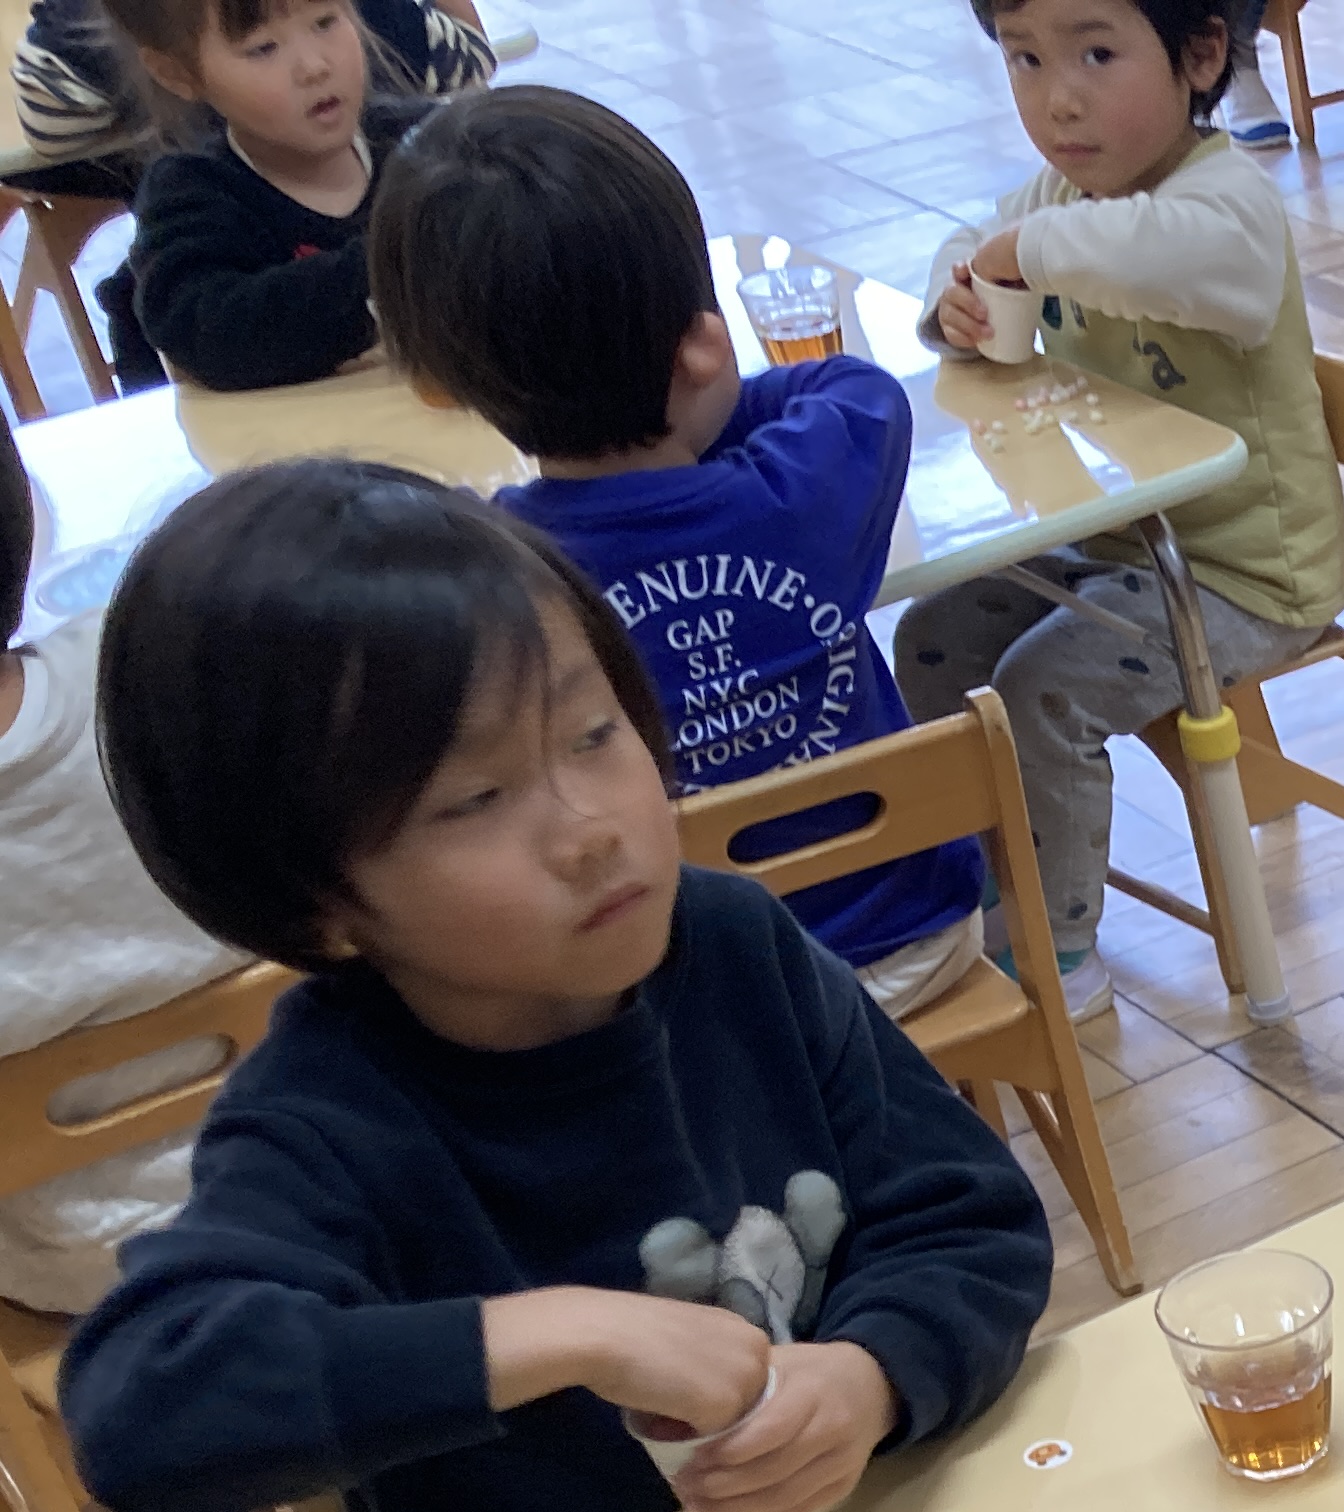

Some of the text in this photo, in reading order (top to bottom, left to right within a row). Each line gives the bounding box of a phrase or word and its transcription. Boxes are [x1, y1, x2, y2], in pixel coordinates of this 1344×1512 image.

[602, 554, 806, 630] ENUINE
[666, 608, 735, 650] GAP
[687, 643, 741, 681] S.F.
[671, 676, 800, 752] ONDON
[684, 713, 797, 775] TOKYO
